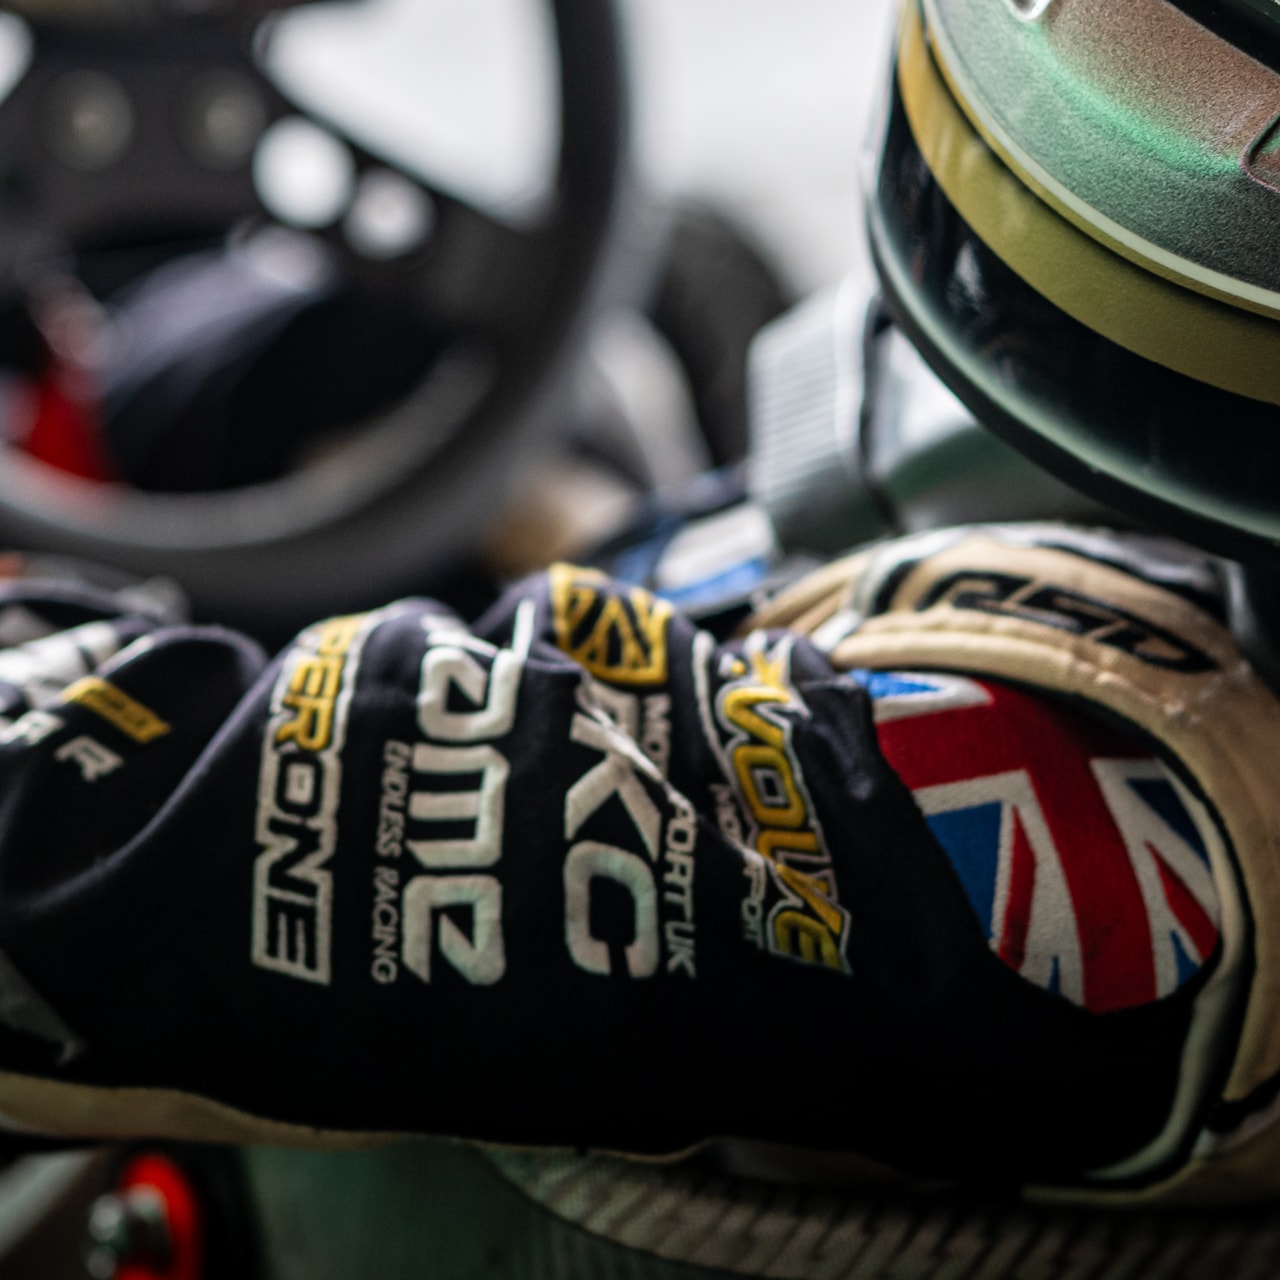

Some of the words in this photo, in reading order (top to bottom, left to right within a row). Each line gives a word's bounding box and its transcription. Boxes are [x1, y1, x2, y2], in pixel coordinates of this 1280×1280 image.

[375, 739, 412, 859] ENDLESS
[370, 865, 404, 986] RACING
[664, 918, 698, 981] UK
